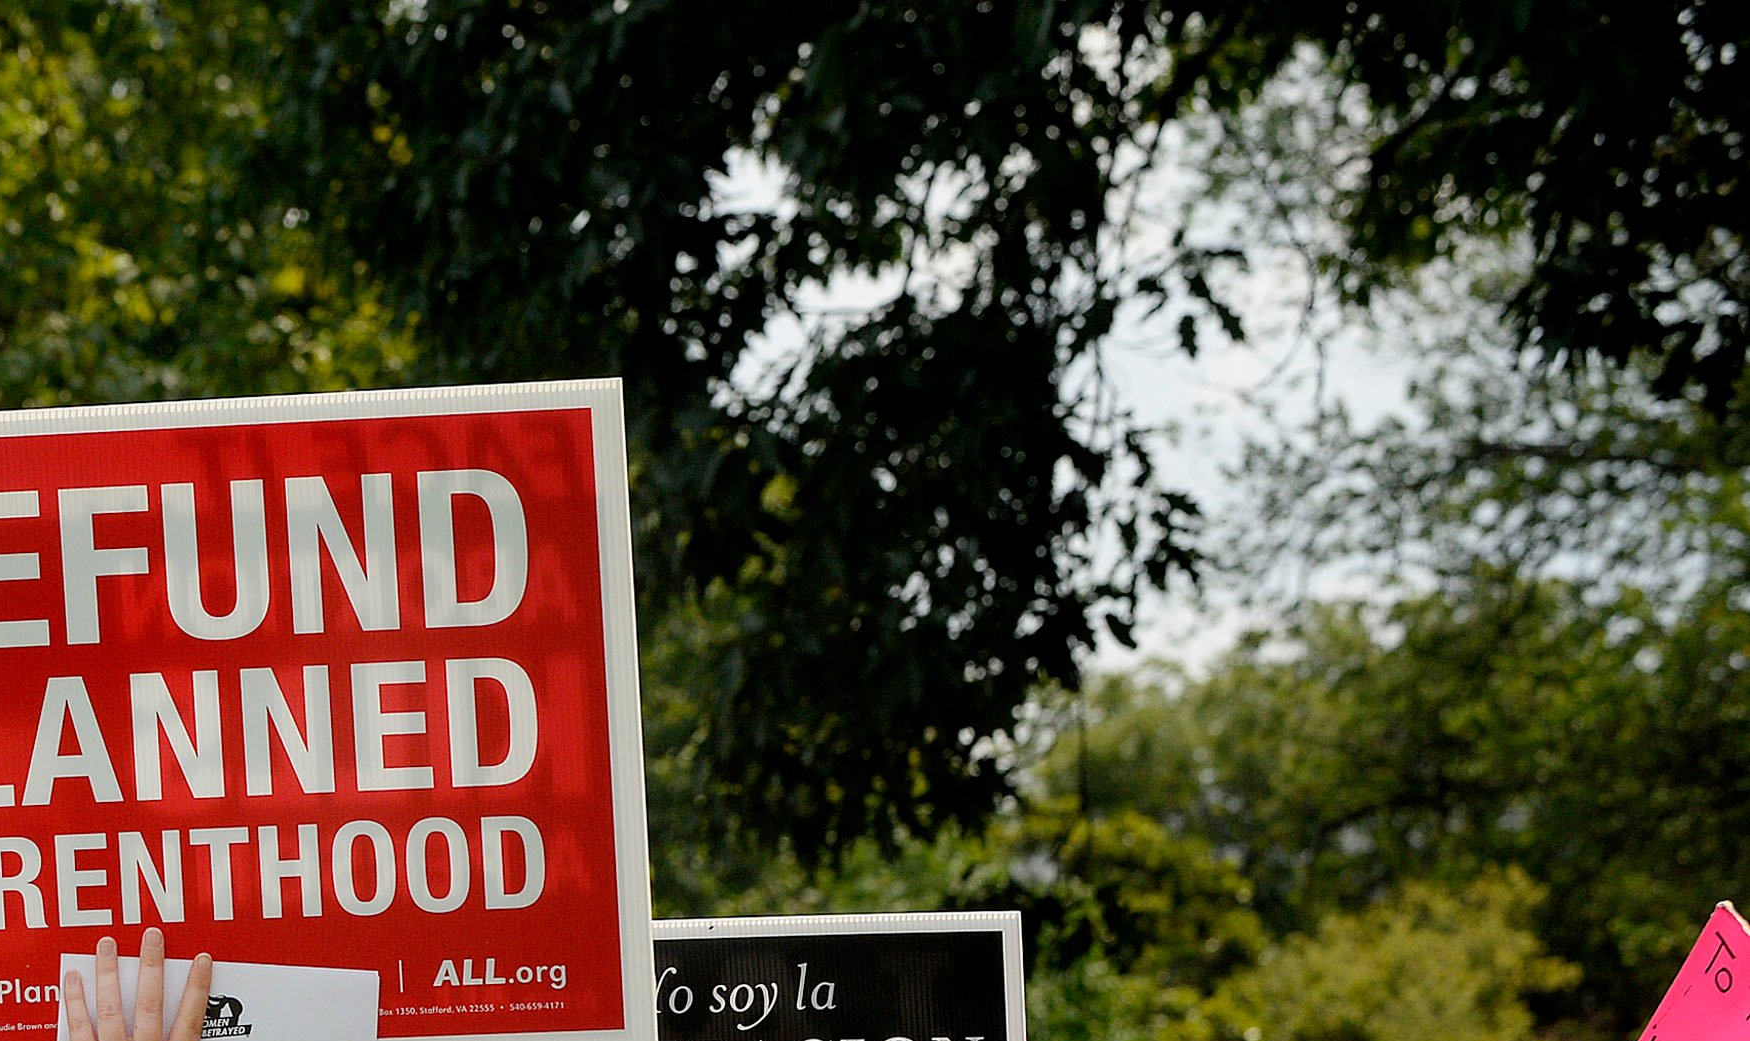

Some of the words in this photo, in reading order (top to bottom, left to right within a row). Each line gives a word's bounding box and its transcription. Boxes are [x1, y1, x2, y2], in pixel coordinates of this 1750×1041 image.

[433, 958, 566, 990] ALL.org
[710, 980, 778, 1030] soy
[796, 963, 837, 1010] la
[456, 1005, 467, 1013] VA
[469, 1004, 495, 1013] 22555
[17, 1022, 43, 1031] Brown
[202, 1018, 230, 1028] OMEN
